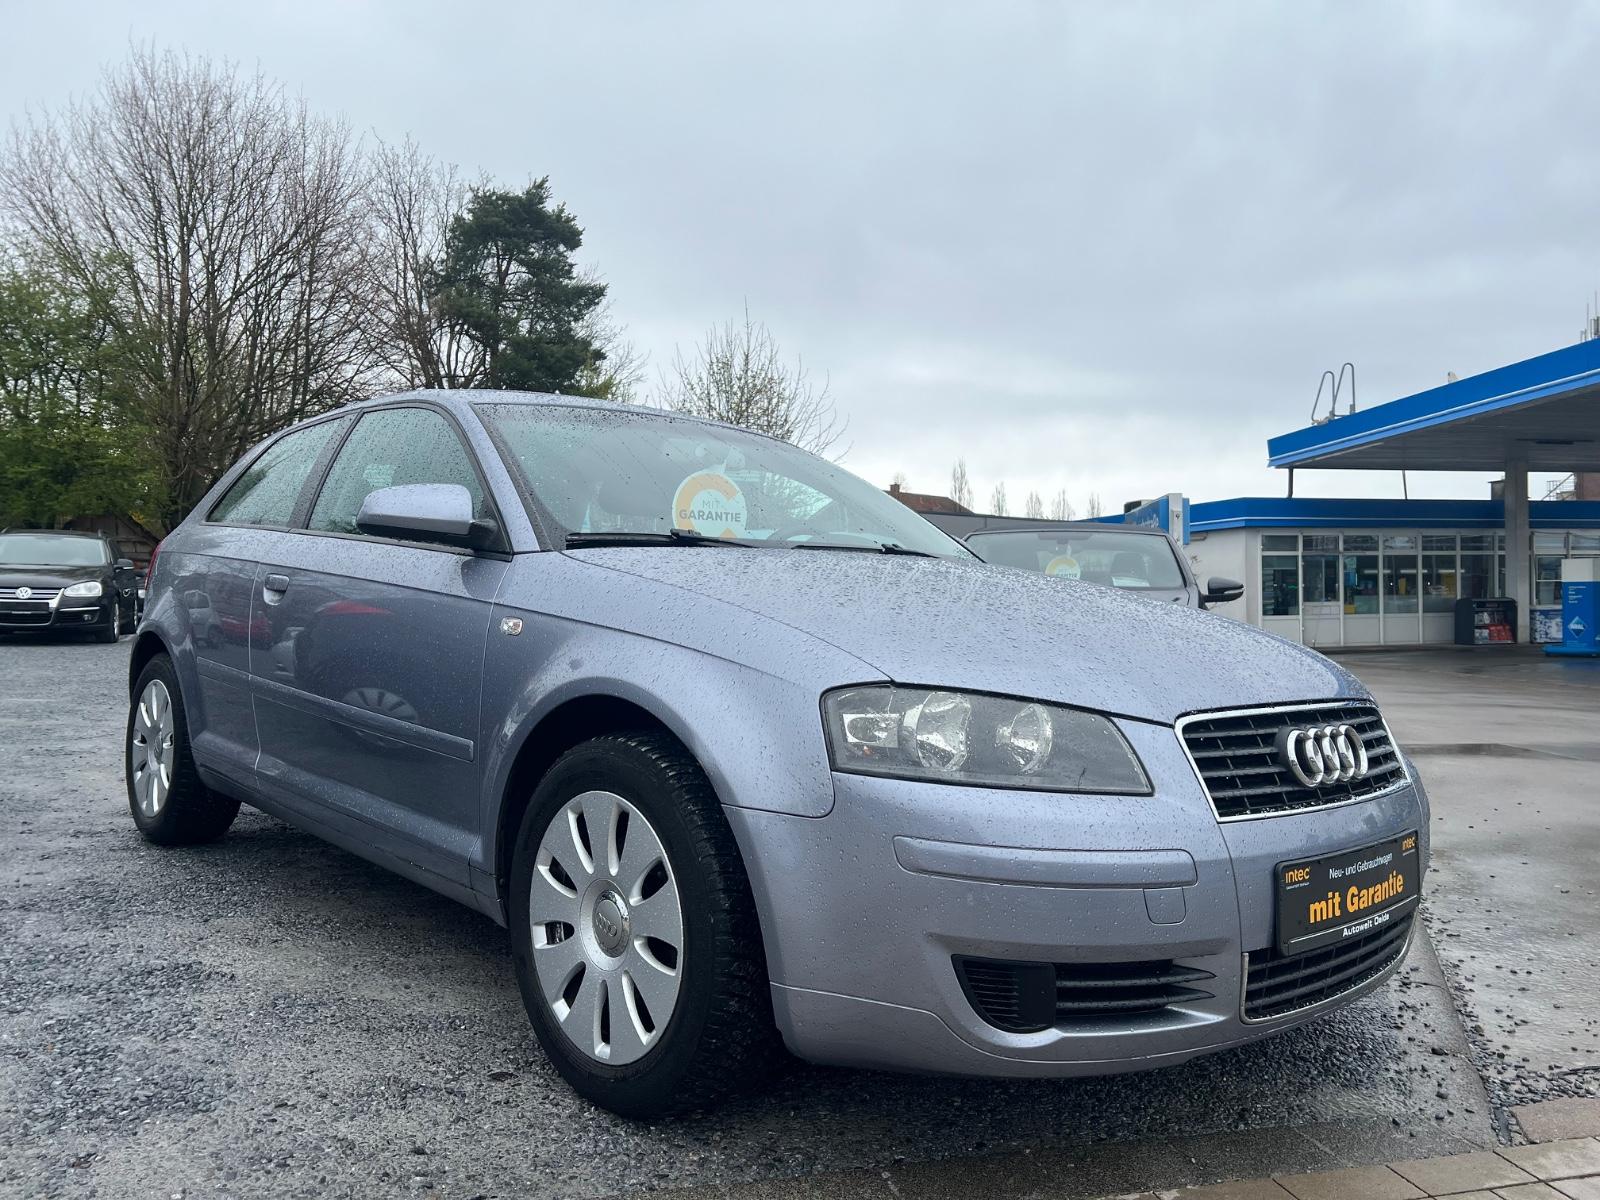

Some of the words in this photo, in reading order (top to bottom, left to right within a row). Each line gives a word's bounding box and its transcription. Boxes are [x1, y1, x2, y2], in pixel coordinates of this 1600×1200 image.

[679, 509, 741, 522] GARANTIE
[1285, 866, 1310, 884] intec
[1329, 868, 1345, 879] Neu-
[1345, 863, 1357, 876] und
[1357, 853, 1393, 873] Gebrauchtwagen
[1309, 891, 1341, 923] mit
[1346, 870, 1404, 913] Garantie
[1342, 919, 1373, 937] Autowelt
